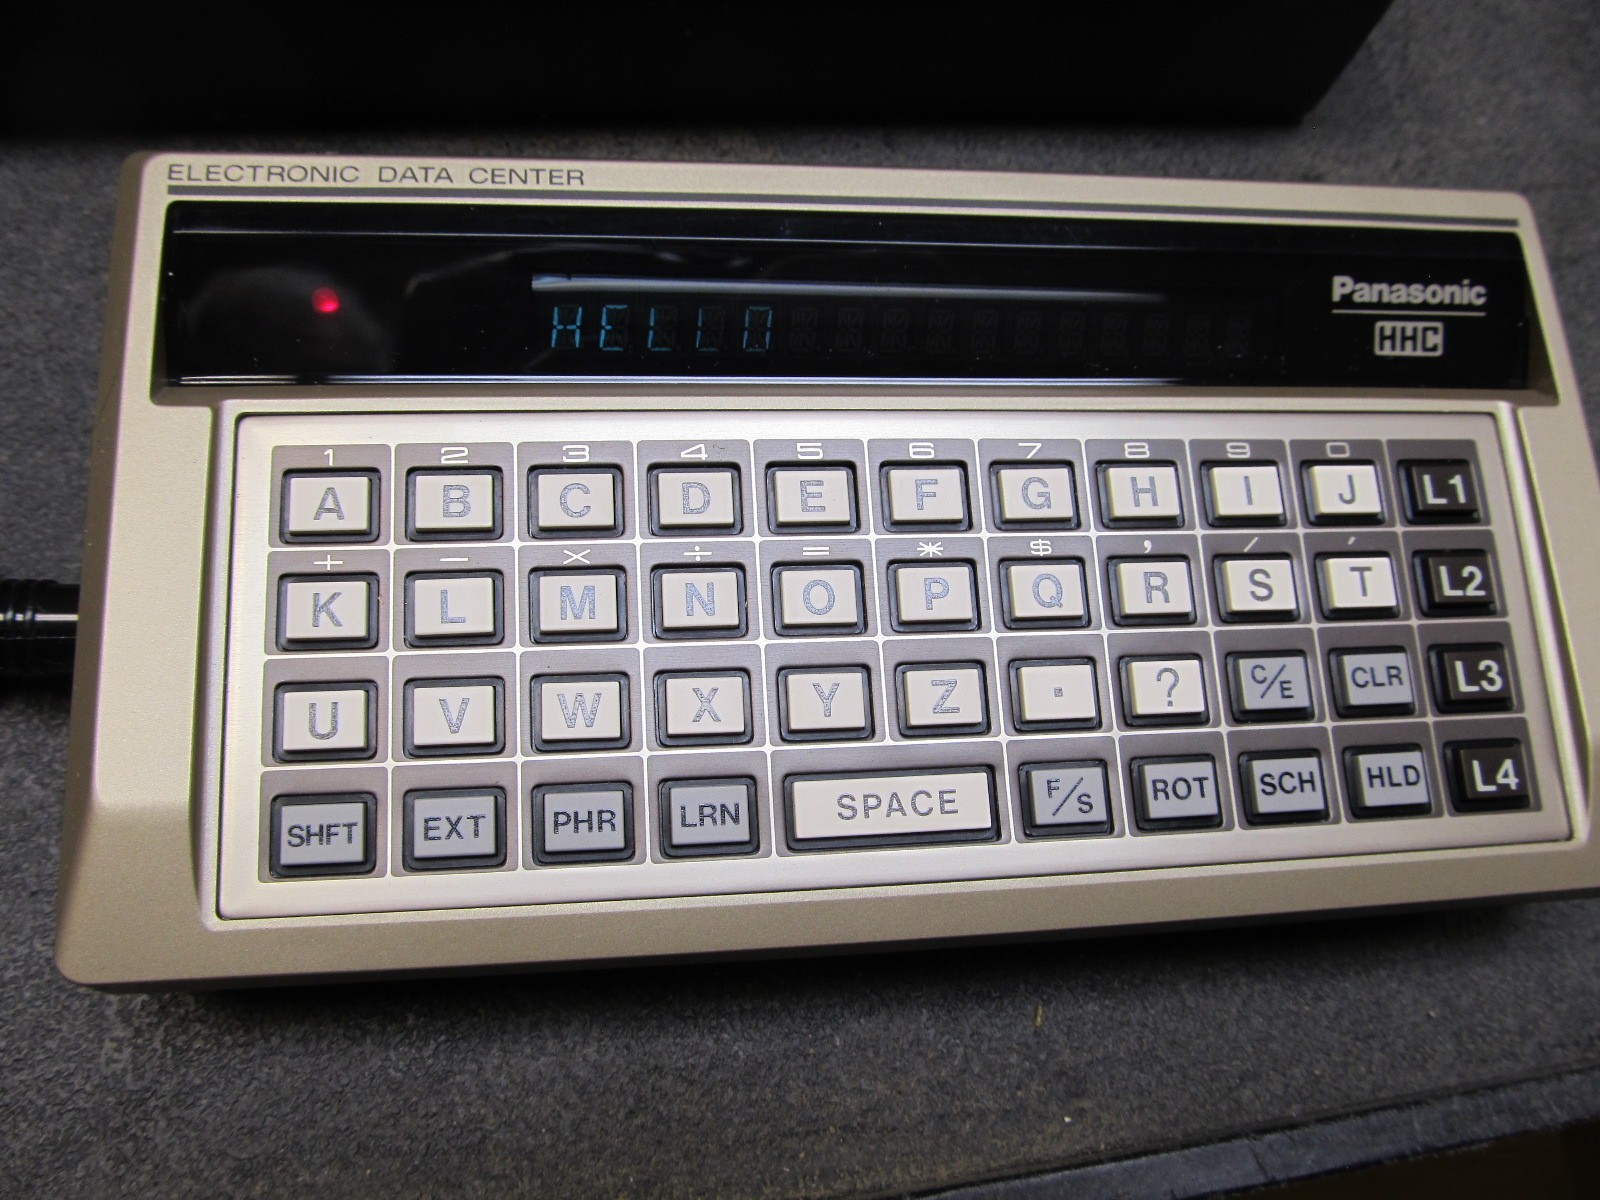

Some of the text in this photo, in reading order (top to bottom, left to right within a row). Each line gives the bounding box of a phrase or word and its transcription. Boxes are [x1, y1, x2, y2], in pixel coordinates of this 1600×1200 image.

[168, 164, 584, 185] ELECTRONIC DATA CENTER
[1332, 276, 1486, 305] Panasonic
[551, 304, 773, 352] HELLO
[1378, 325, 1441, 353] HHC
[323, 449, 333, 466] 1
[440, 447, 469, 464] 2
[562, 445, 590, 461] 3
[681, 443, 708, 460] 4
[796, 443, 825, 460] 5
[908, 442, 936, 459] 6
[1017, 442, 1043, 459] 7
[1124, 442, 1150, 459] 8
[1225, 442, 1251, 458] 9
[314, 487, 344, 520] A
[443, 485, 471, 518] B
[560, 483, 591, 518] C
[682, 482, 711, 514] D
[800, 480, 826, 512] E
[915, 479, 938, 510] F
[1022, 477, 1051, 510] G
[1131, 476, 1158, 507] H
[1244, 476, 1253, 505] I
[1339, 475, 1356, 504] J
[1423, 475, 1465, 504] L1
[1029, 539, 1052, 557] $
[924, 578, 949, 610] P
[1032, 573, 1063, 608] Q
[1143, 572, 1170, 603] R
[1249, 569, 1273, 601] S
[1350, 566, 1372, 597] T
[1440, 566, 1485, 596] L2
[312, 592, 343, 627] K
[440, 590, 466, 624] L
[560, 586, 595, 620] M
[685, 582, 715, 616] N
[803, 580, 835, 615] O
[1157, 668, 1179, 706] ?
[1351, 666, 1403, 688] CLR
[1455, 660, 1502, 692] L3
[557, 693, 601, 728] W
[692, 688, 721, 722] X
[812, 683, 840, 717] Y
[931, 679, 960, 714] Z
[309, 702, 338, 740] U
[439, 698, 470, 734] V
[1152, 777, 1208, 801] ROT
[1260, 771, 1316, 795] SCH
[1367, 765, 1420, 788] HLD
[1473, 759, 1519, 791] L4
[681, 803, 740, 827] LRN
[837, 789, 958, 820] SPACE
[288, 822, 357, 847] SHFT
[424, 815, 485, 841] EXT
[554, 810, 616, 834] PHR
